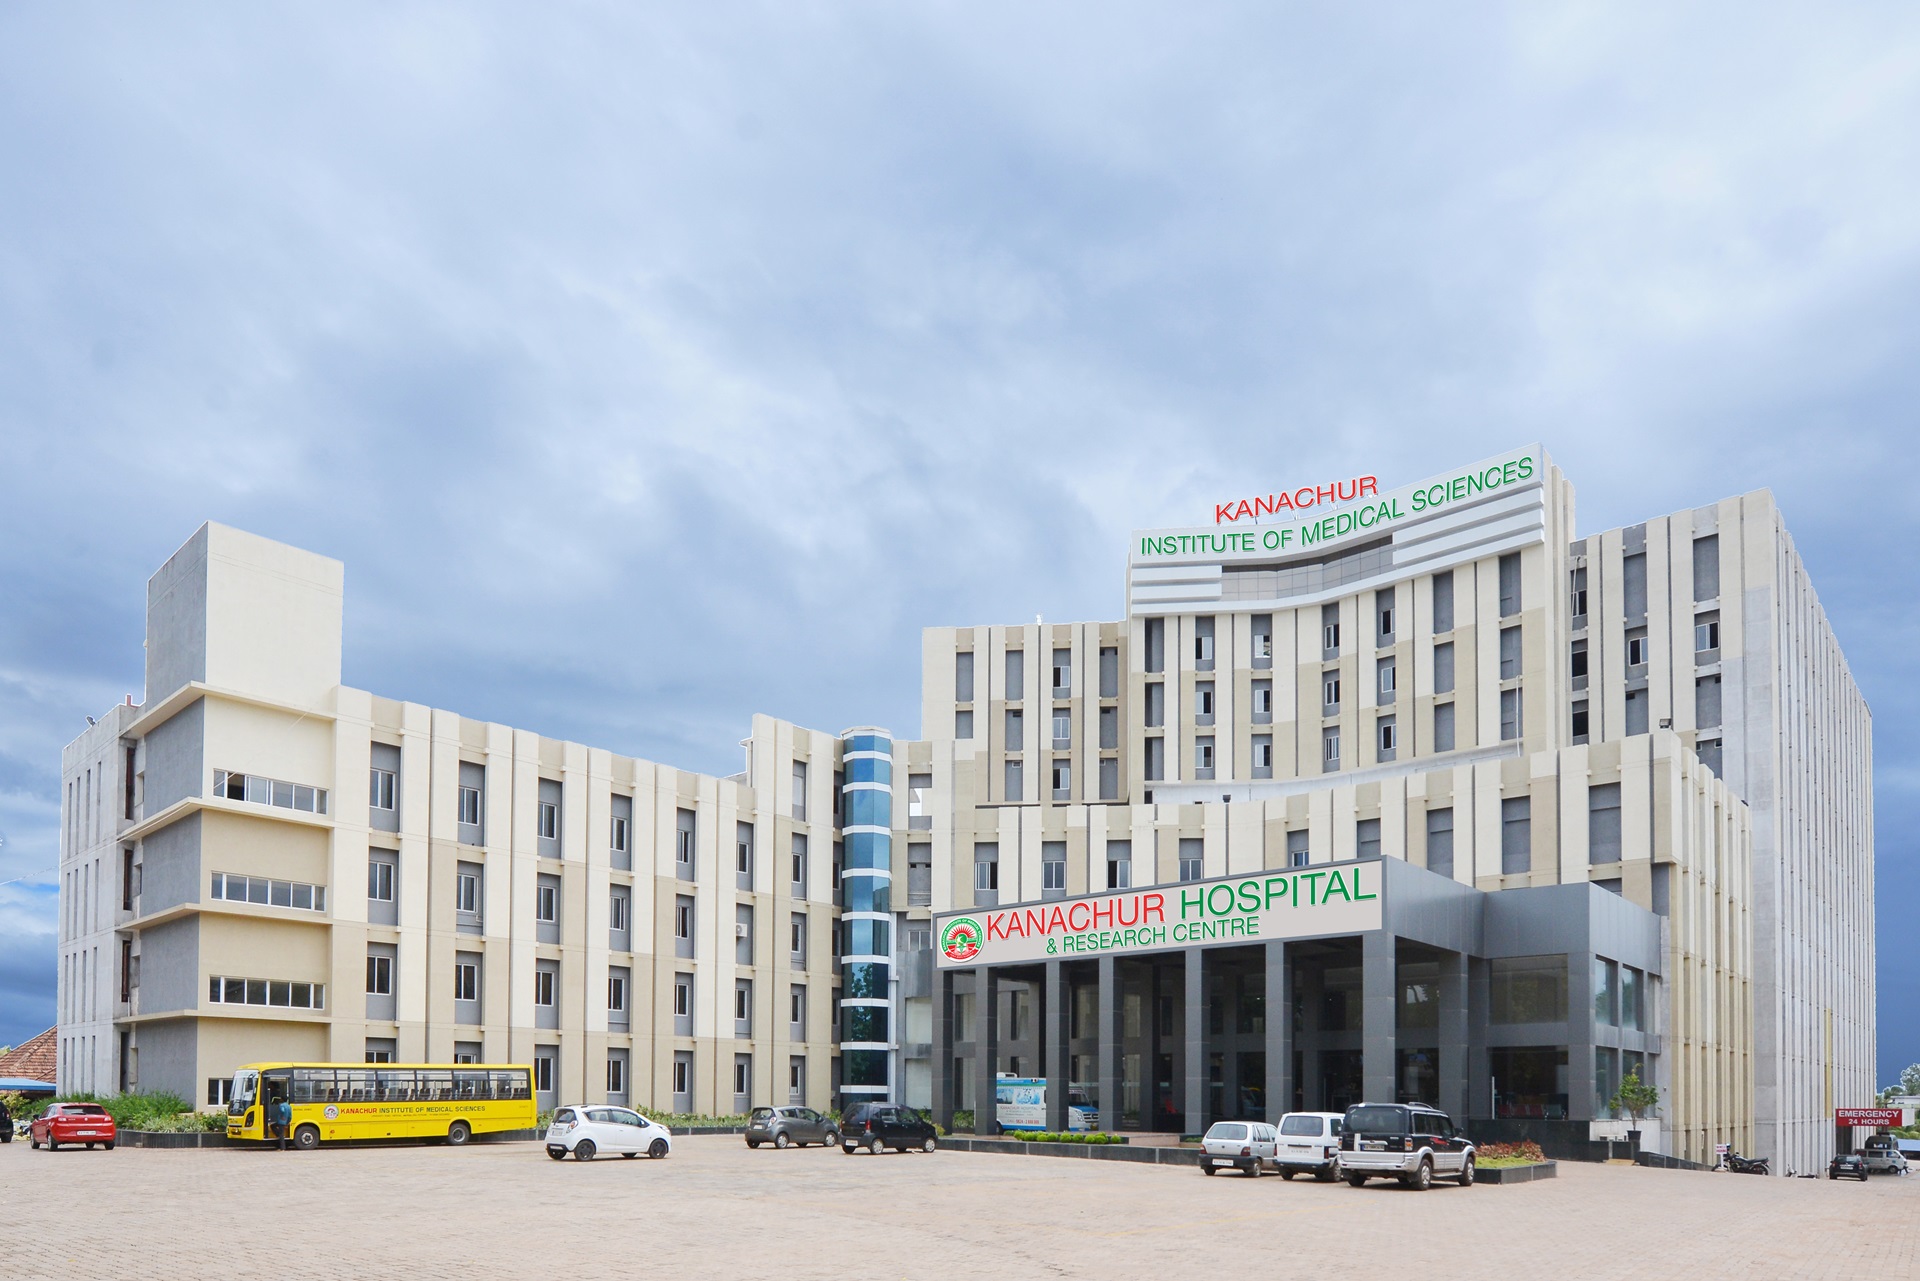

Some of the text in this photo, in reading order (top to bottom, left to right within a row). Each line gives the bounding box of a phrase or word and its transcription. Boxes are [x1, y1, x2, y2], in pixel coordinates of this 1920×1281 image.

[1140, 455, 1533, 555] INSTITUTE OF MEDICAL SCIENCES
[1215, 475, 1378, 524] KANACHUR
[987, 867, 1377, 941] KANACHUR HOSPITAL
[1046, 916, 1260, 954] & RESEARCH CENTRE
[1838, 1110, 1899, 1118] EMERGENCY
